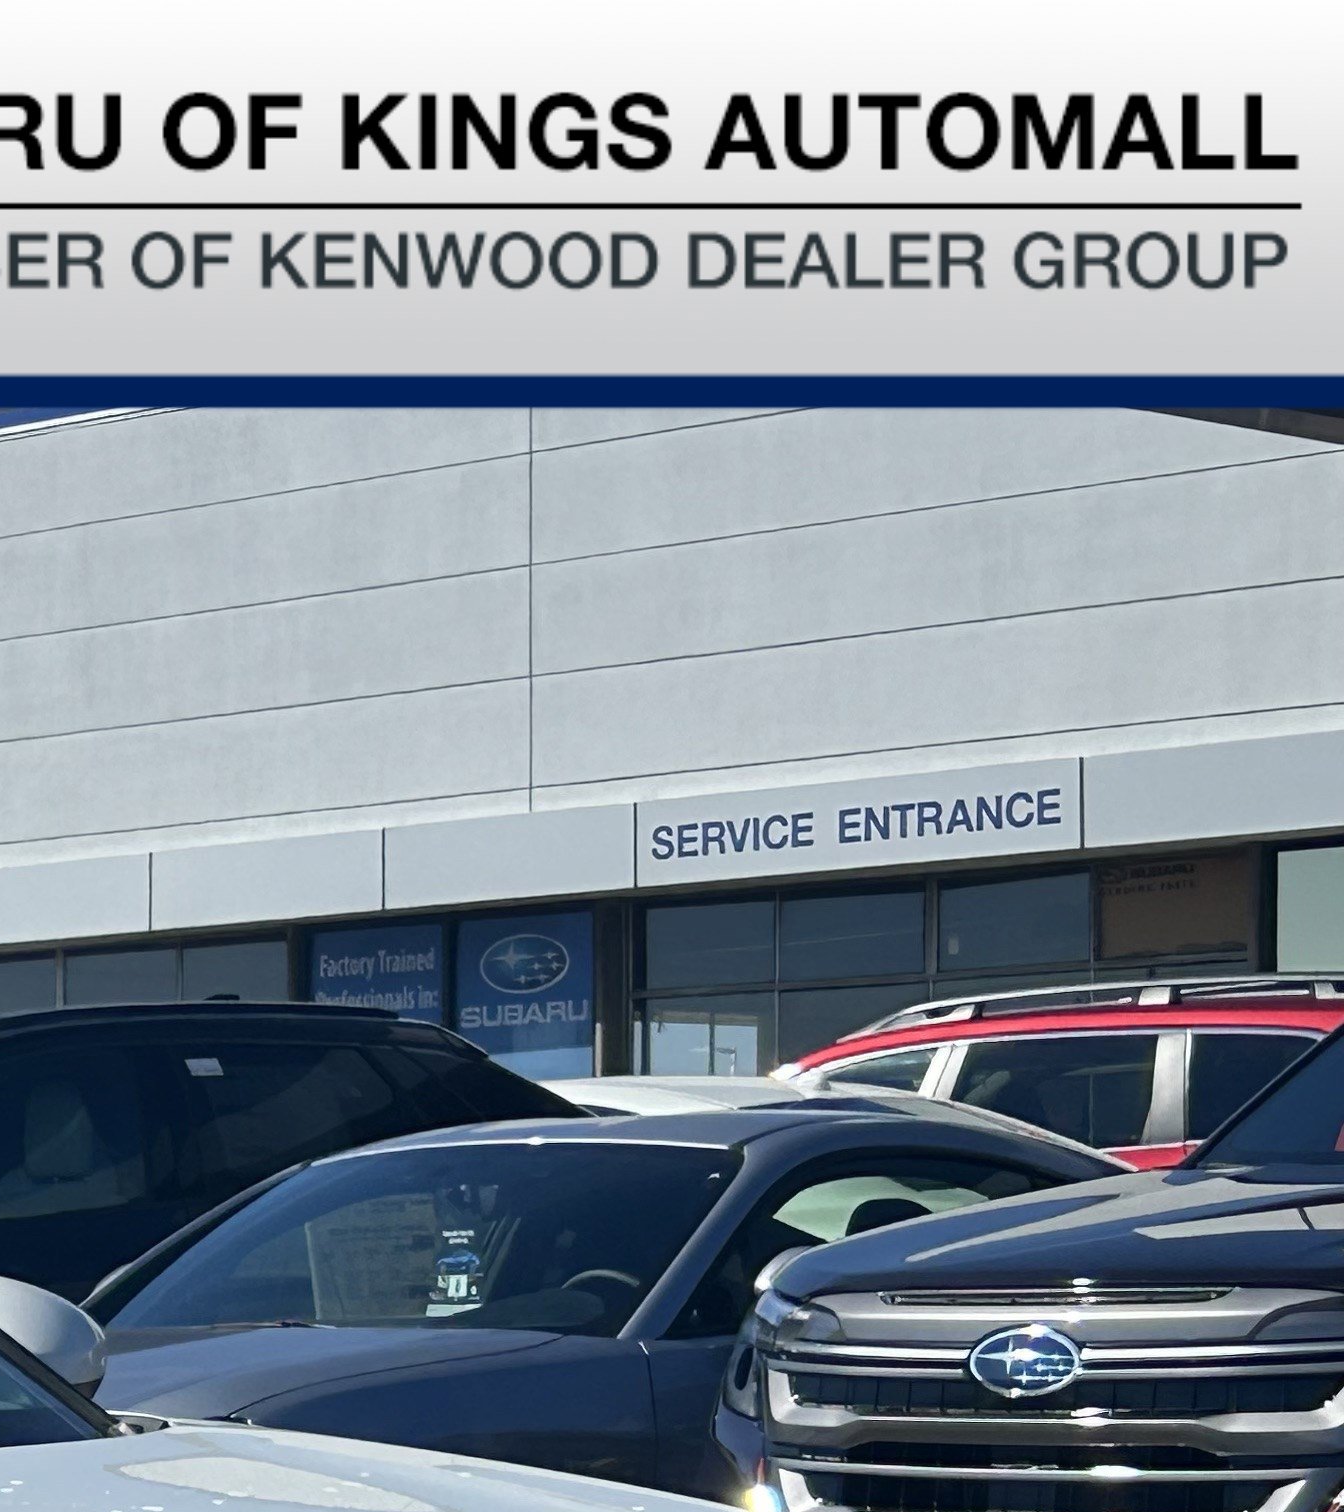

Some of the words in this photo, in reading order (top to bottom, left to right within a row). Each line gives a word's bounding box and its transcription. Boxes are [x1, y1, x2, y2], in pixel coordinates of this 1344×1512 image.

[651, 811, 814, 860] SERVICE
[838, 788, 1062, 844] ENTRANCE
[319, 954, 375, 980] Factory
[377, 947, 435, 974] Trained
[460, 999, 590, 1029] SUBARU
